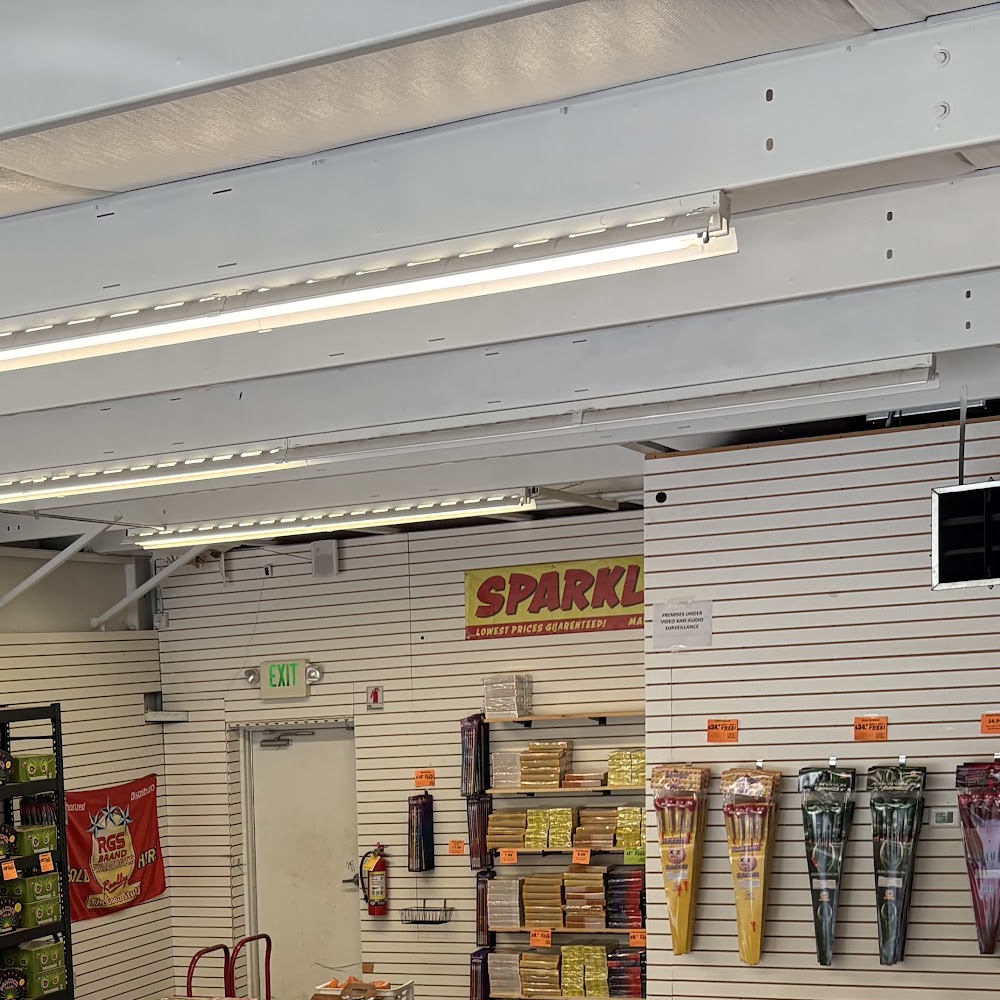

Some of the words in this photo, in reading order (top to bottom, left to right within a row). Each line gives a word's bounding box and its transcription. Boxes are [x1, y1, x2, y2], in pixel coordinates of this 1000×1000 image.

[475, 565, 644, 618] SPARKL
[476, 624, 509, 637] LOWEST
[511, 622, 543, 635] PRICES
[545, 619, 607, 633] GUARENTEED!
[628, 617, 644, 627] MA
[269, 663, 298, 688] EXIT
[96, 831, 127, 854] RGS
[99, 848, 128, 863] BRAND
